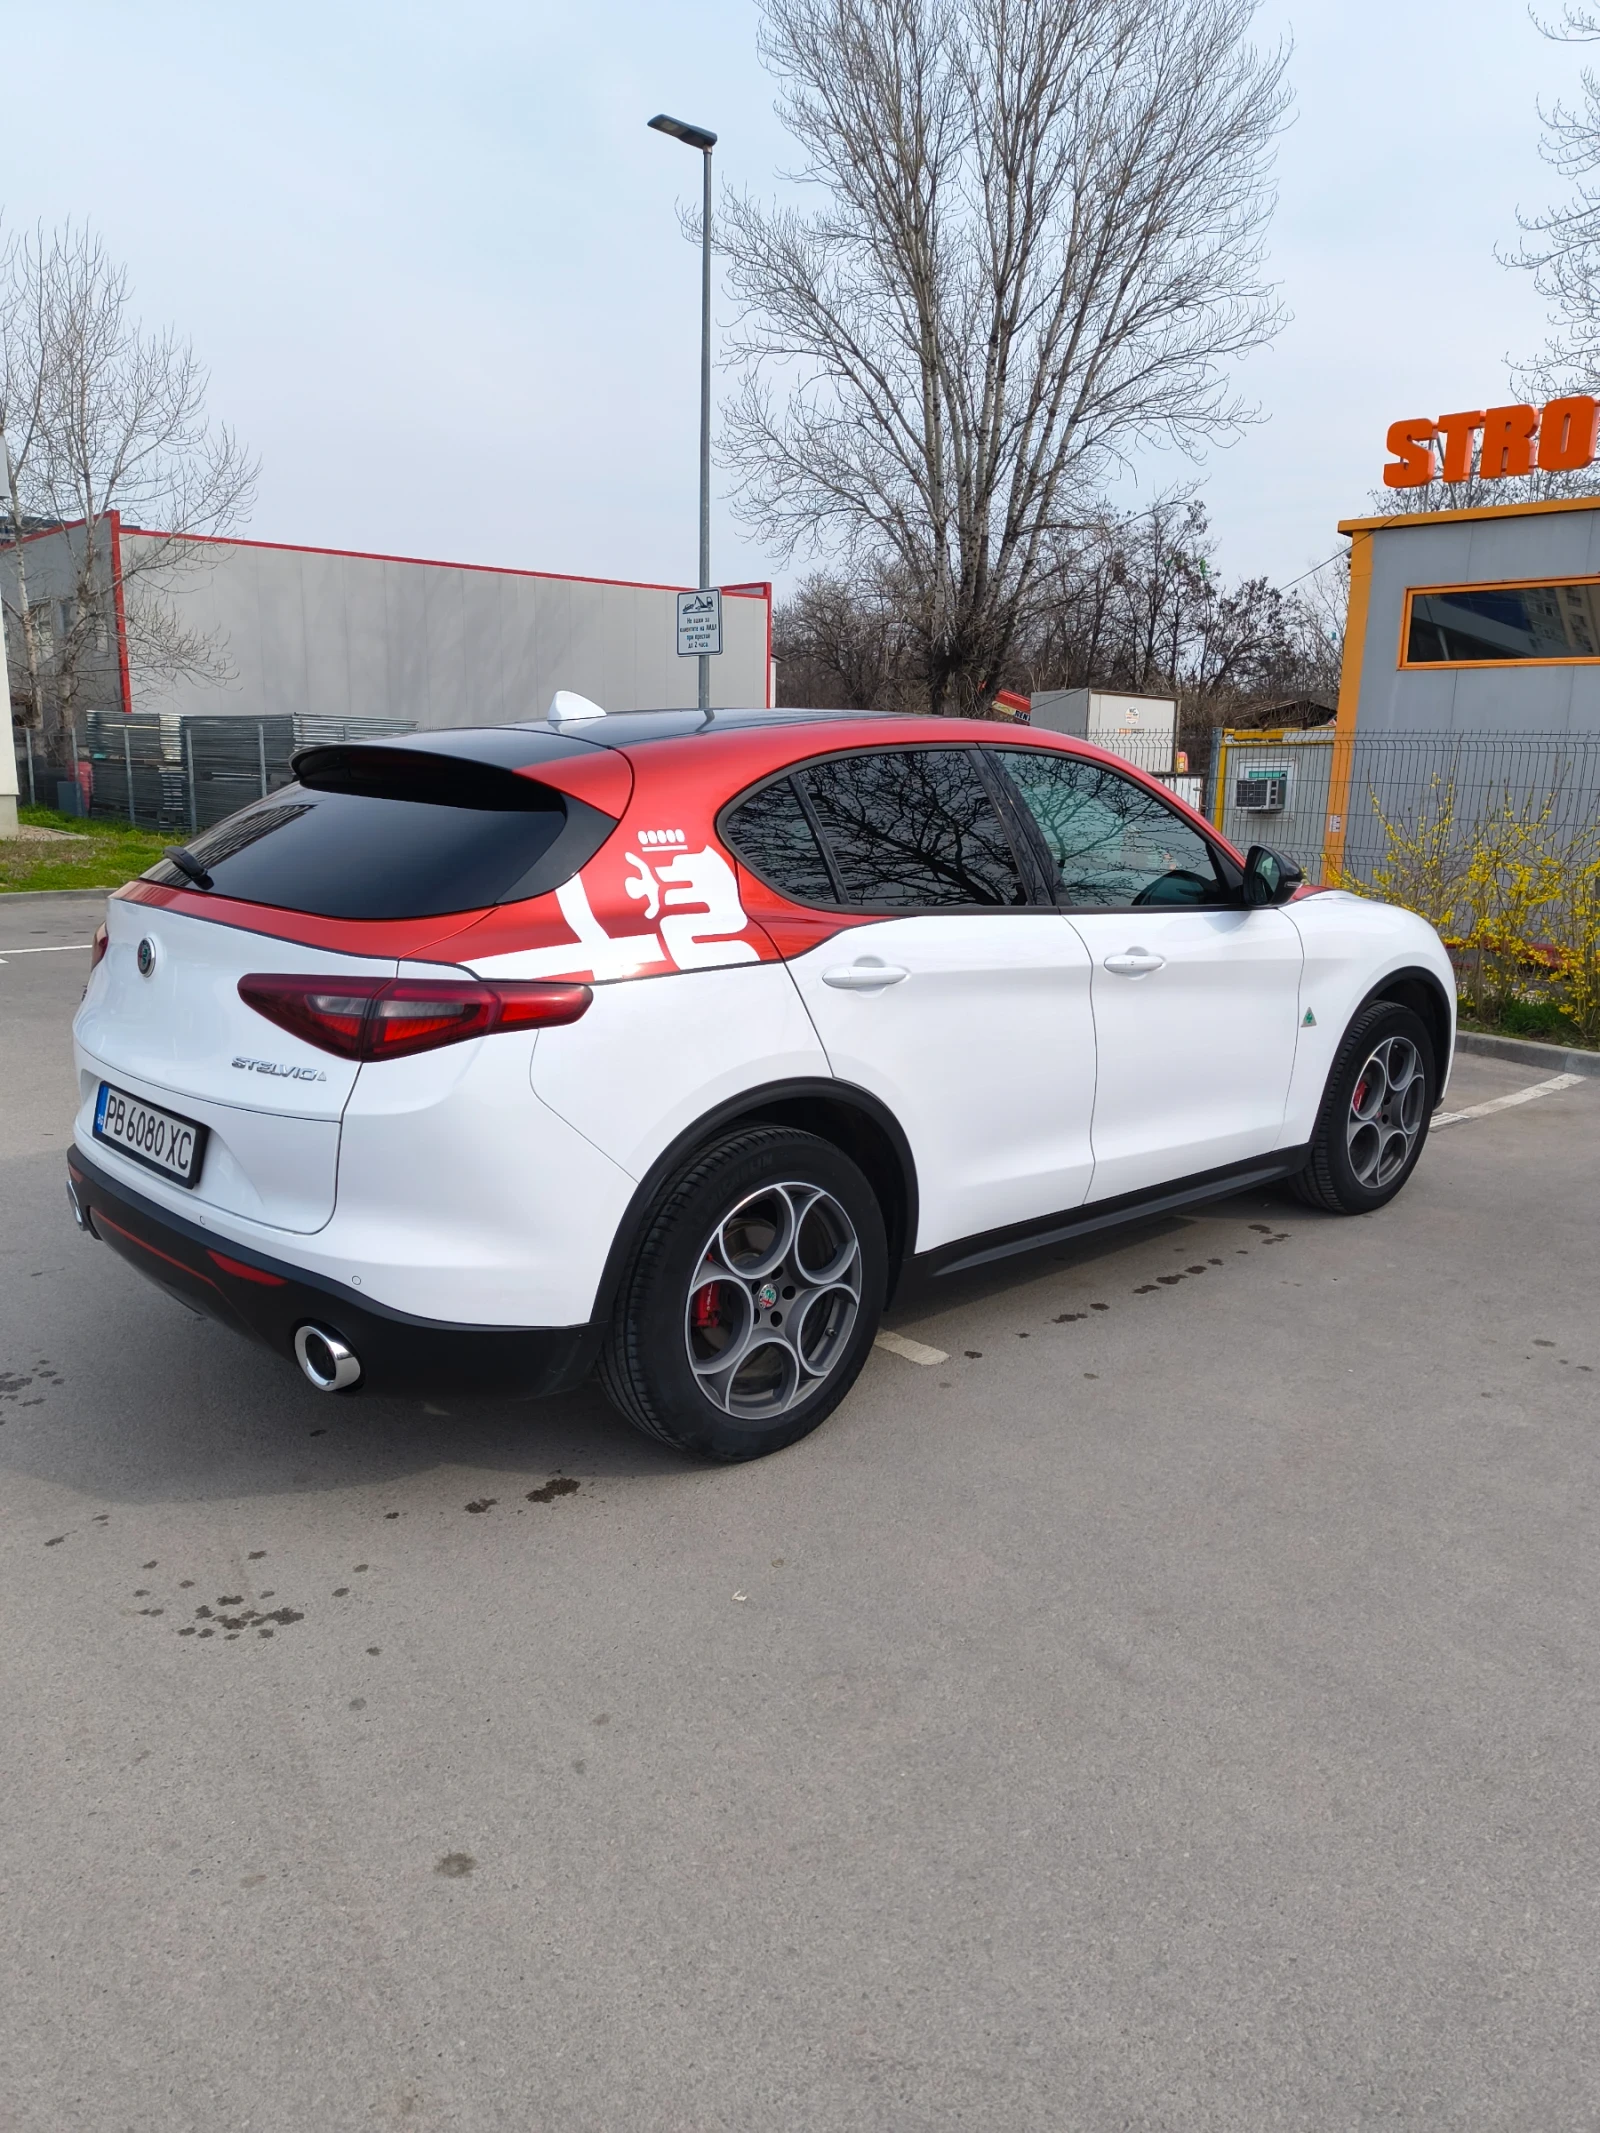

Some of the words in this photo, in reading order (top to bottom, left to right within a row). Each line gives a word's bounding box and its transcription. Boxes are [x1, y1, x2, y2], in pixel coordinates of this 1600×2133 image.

[1383, 395, 1597, 488] STRO
[231, 1057, 318, 1081] STELVIO
[105, 1094, 125, 1136] PB
[126, 1107, 165, 1157] 6080
[165, 1125, 191, 1170] XC
